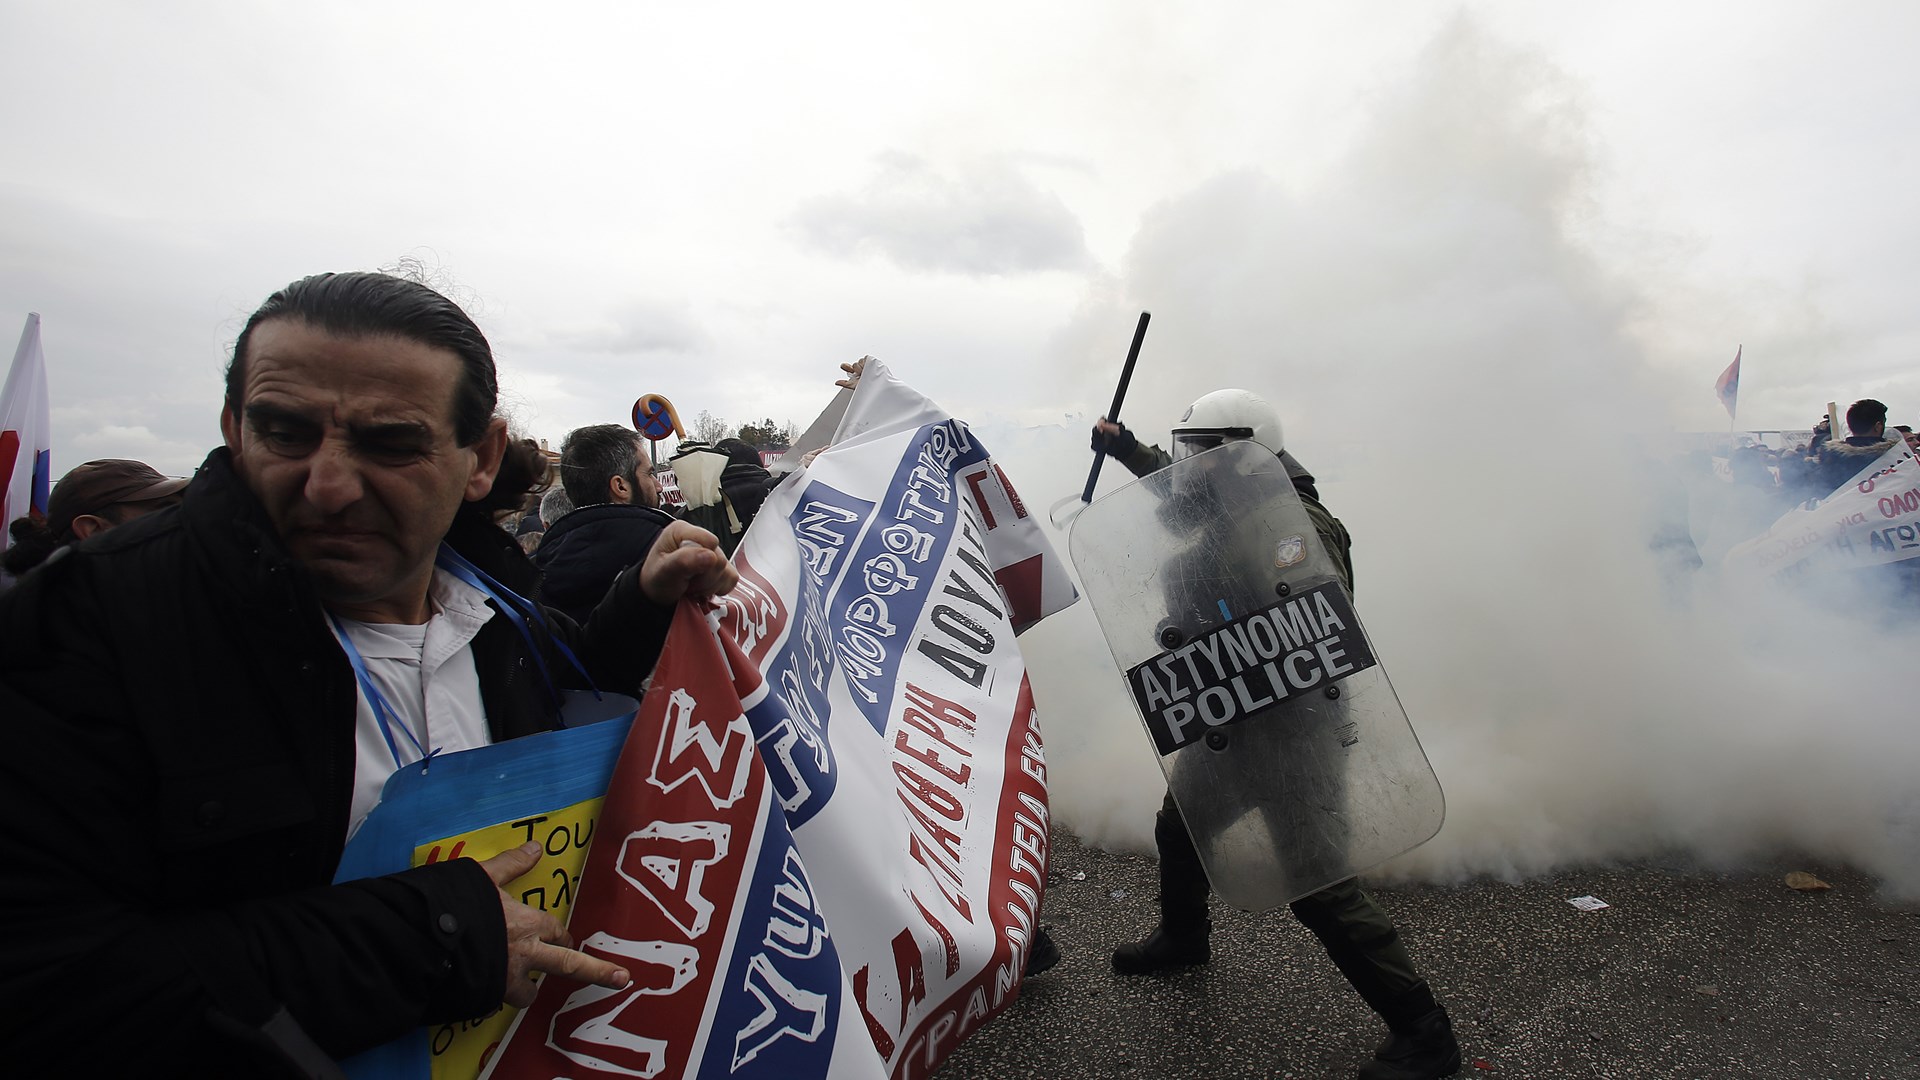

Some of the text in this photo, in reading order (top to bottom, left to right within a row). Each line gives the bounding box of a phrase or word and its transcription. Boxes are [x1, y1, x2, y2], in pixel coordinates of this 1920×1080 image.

[1140, 590, 1346, 713] ΑΣΤΥΝΟΜΙΑ
[1162, 635, 1354, 745] POLICE
[544, 687, 756, 1080] ΝΑΣ
